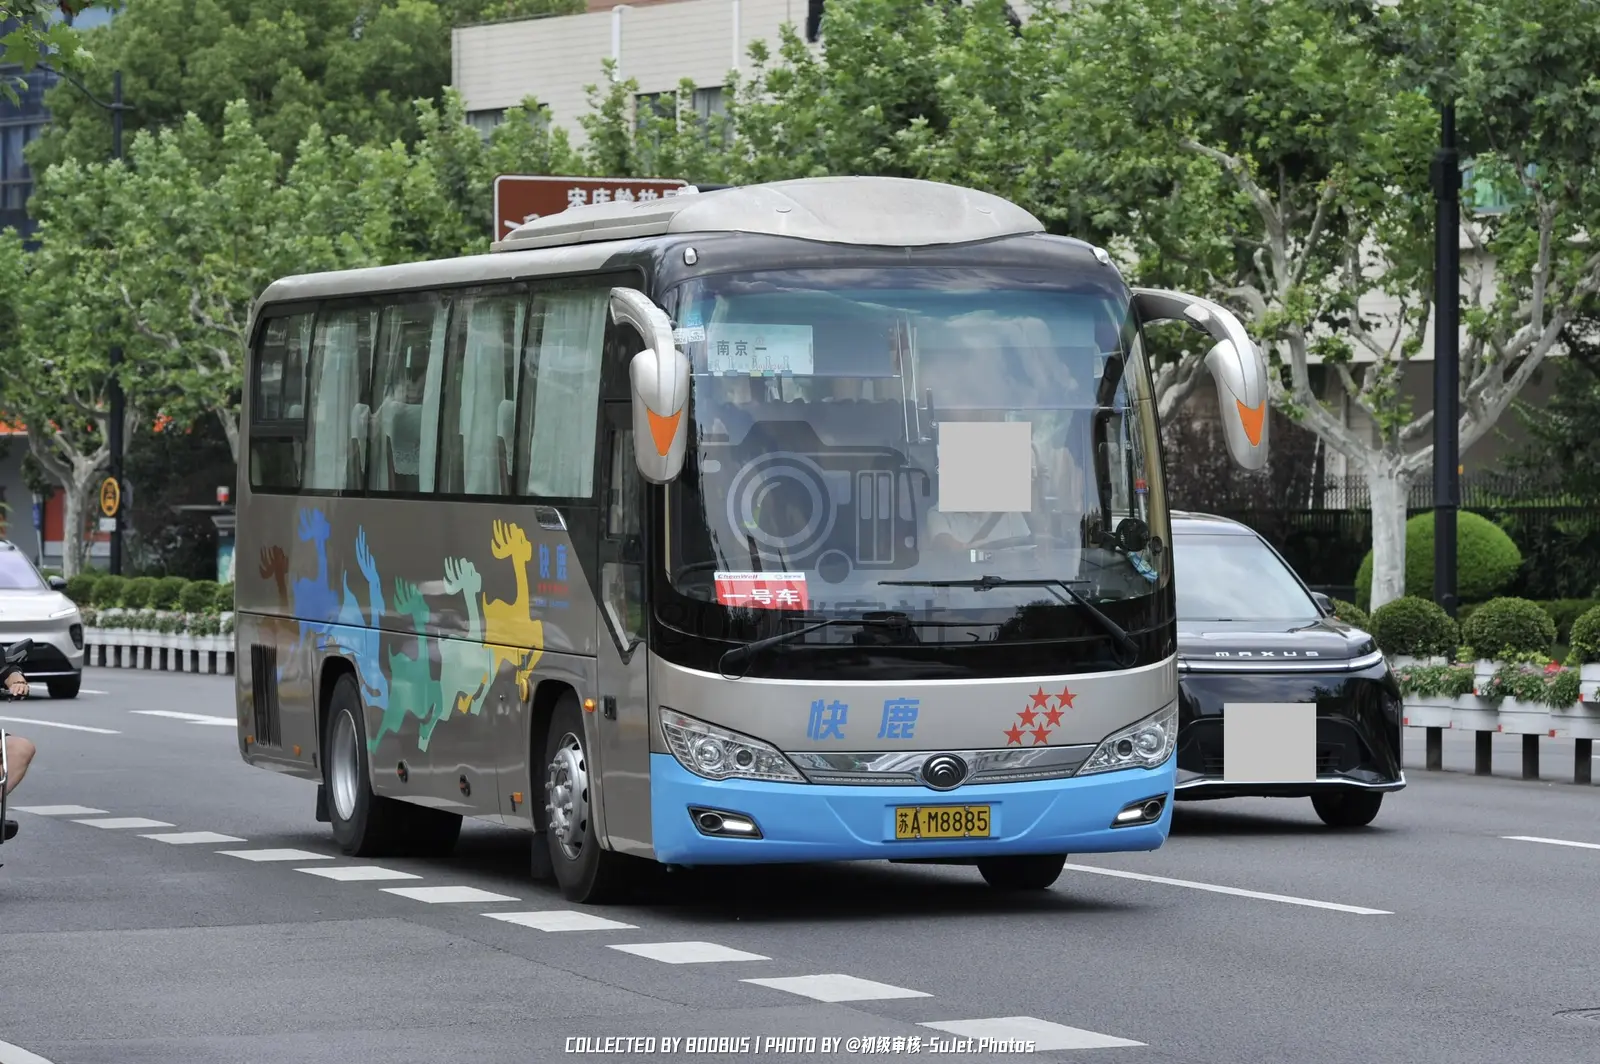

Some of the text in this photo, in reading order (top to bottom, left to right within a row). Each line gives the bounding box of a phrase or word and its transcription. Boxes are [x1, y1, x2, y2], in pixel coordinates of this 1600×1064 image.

[722, 589, 801, 605] 一号车
[806, 698, 920, 740] 快鹿
